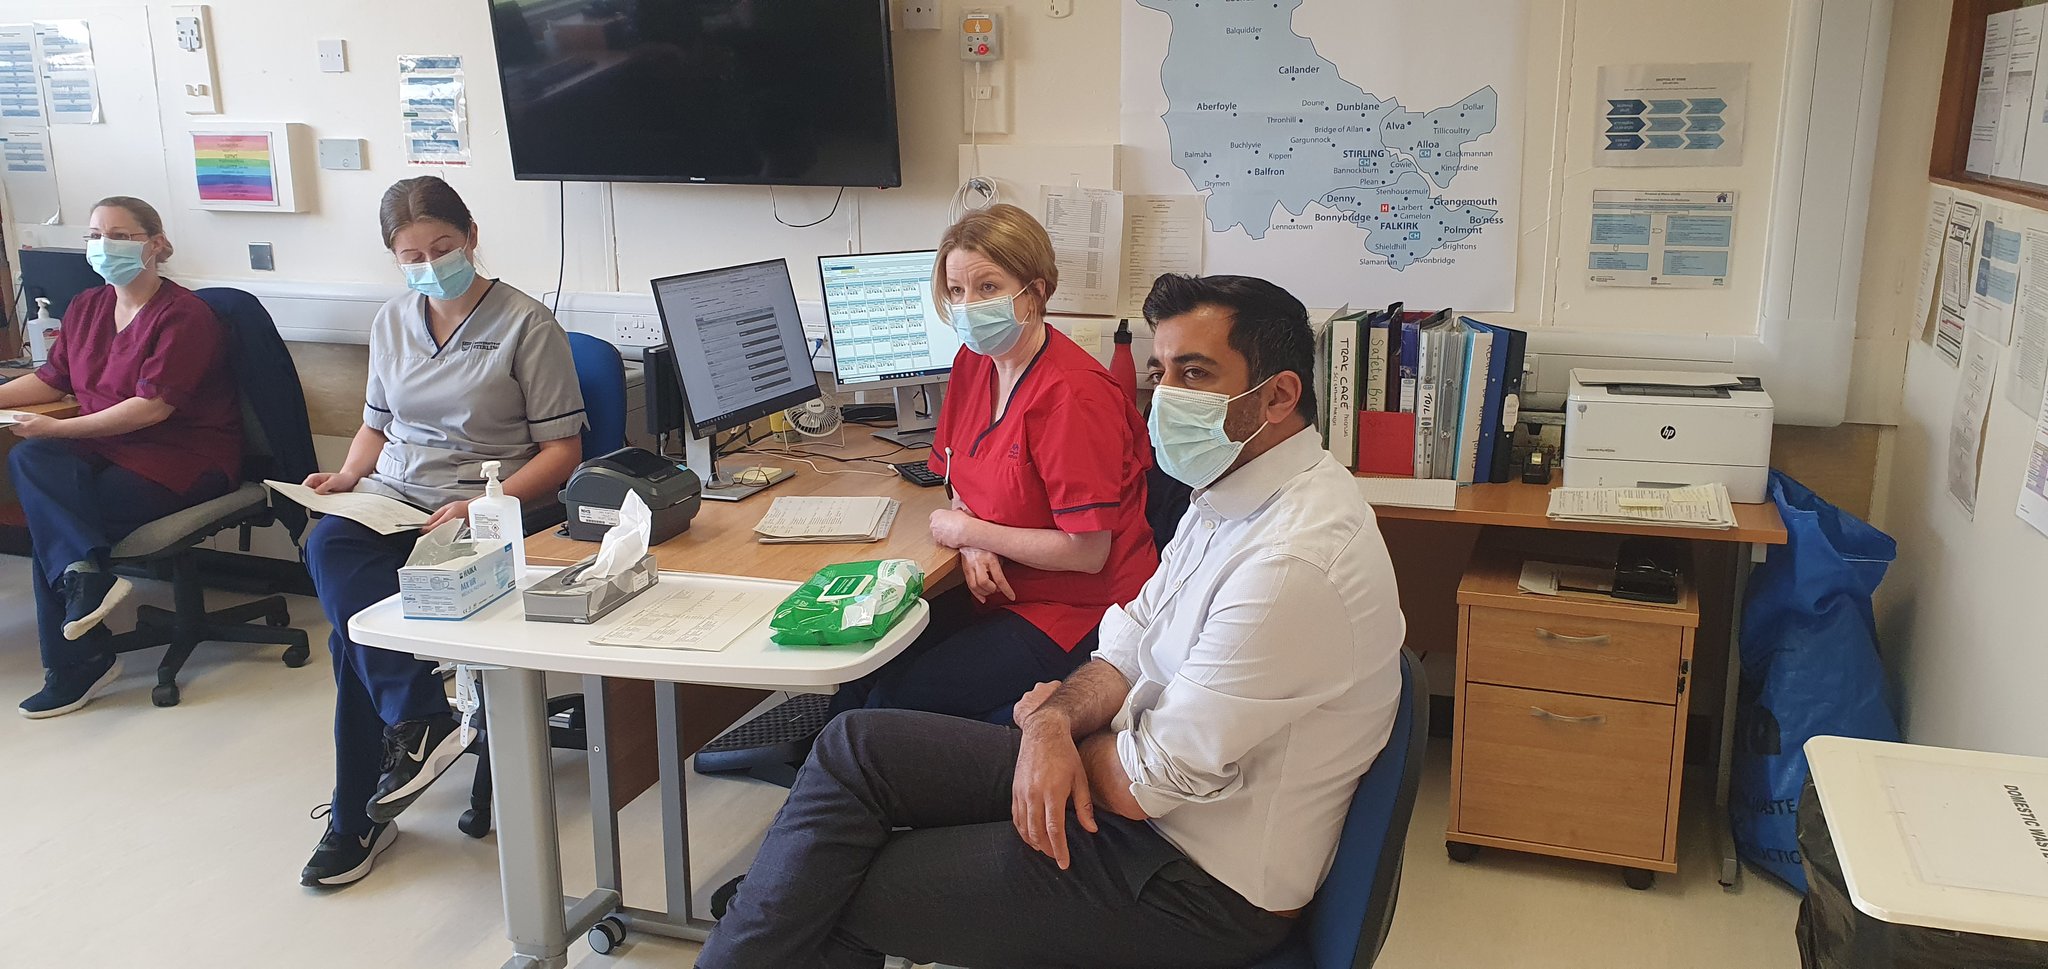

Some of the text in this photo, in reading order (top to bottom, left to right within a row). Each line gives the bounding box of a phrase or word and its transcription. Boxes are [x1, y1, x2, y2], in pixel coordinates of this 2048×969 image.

[1226, 27, 1262, 35] Balquidder
[1278, 65, 1320, 74] Callander
[1196, 102, 1238, 112] Aberfoyle
[1336, 102, 1380, 111] Dunblane
[1385, 122, 1406, 130] Alva
[1290, 136, 1331, 144] Gargunnock
[1416, 140, 1440, 149] Alloa
[1230, 141, 1262, 149] Buchlyvie
[1268, 152, 1292, 160] Kippen
[1343, 149, 1385, 158] STIRLING
[1254, 168, 1285, 176] Balfron
[1204, 180, 1230, 188] Drymen
[1326, 194, 1355, 204] Denny
[1434, 197, 1498, 207] Grangemouth
[1315, 213, 1371, 222] Bonnybridge
[1400, 212, 1431, 220] Camelon
[1469, 215, 1504, 224] Bo'ness
[1380, 222, 1419, 230] FALKIRK
[1444, 226, 1483, 234] Polmont
[1442, 242, 1477, 251] Brightons
[1415, 257, 1456, 265] Avonbridge
[1340, 338, 1350, 372] TRAK
[1369, 338, 1385, 382] Safety
[1340, 376, 1349, 410] CARE
[1424, 392, 1433, 414] TOIL
[1660, 425, 1676, 440] hp
[2003, 784, 2041, 827] DOMESTIC
